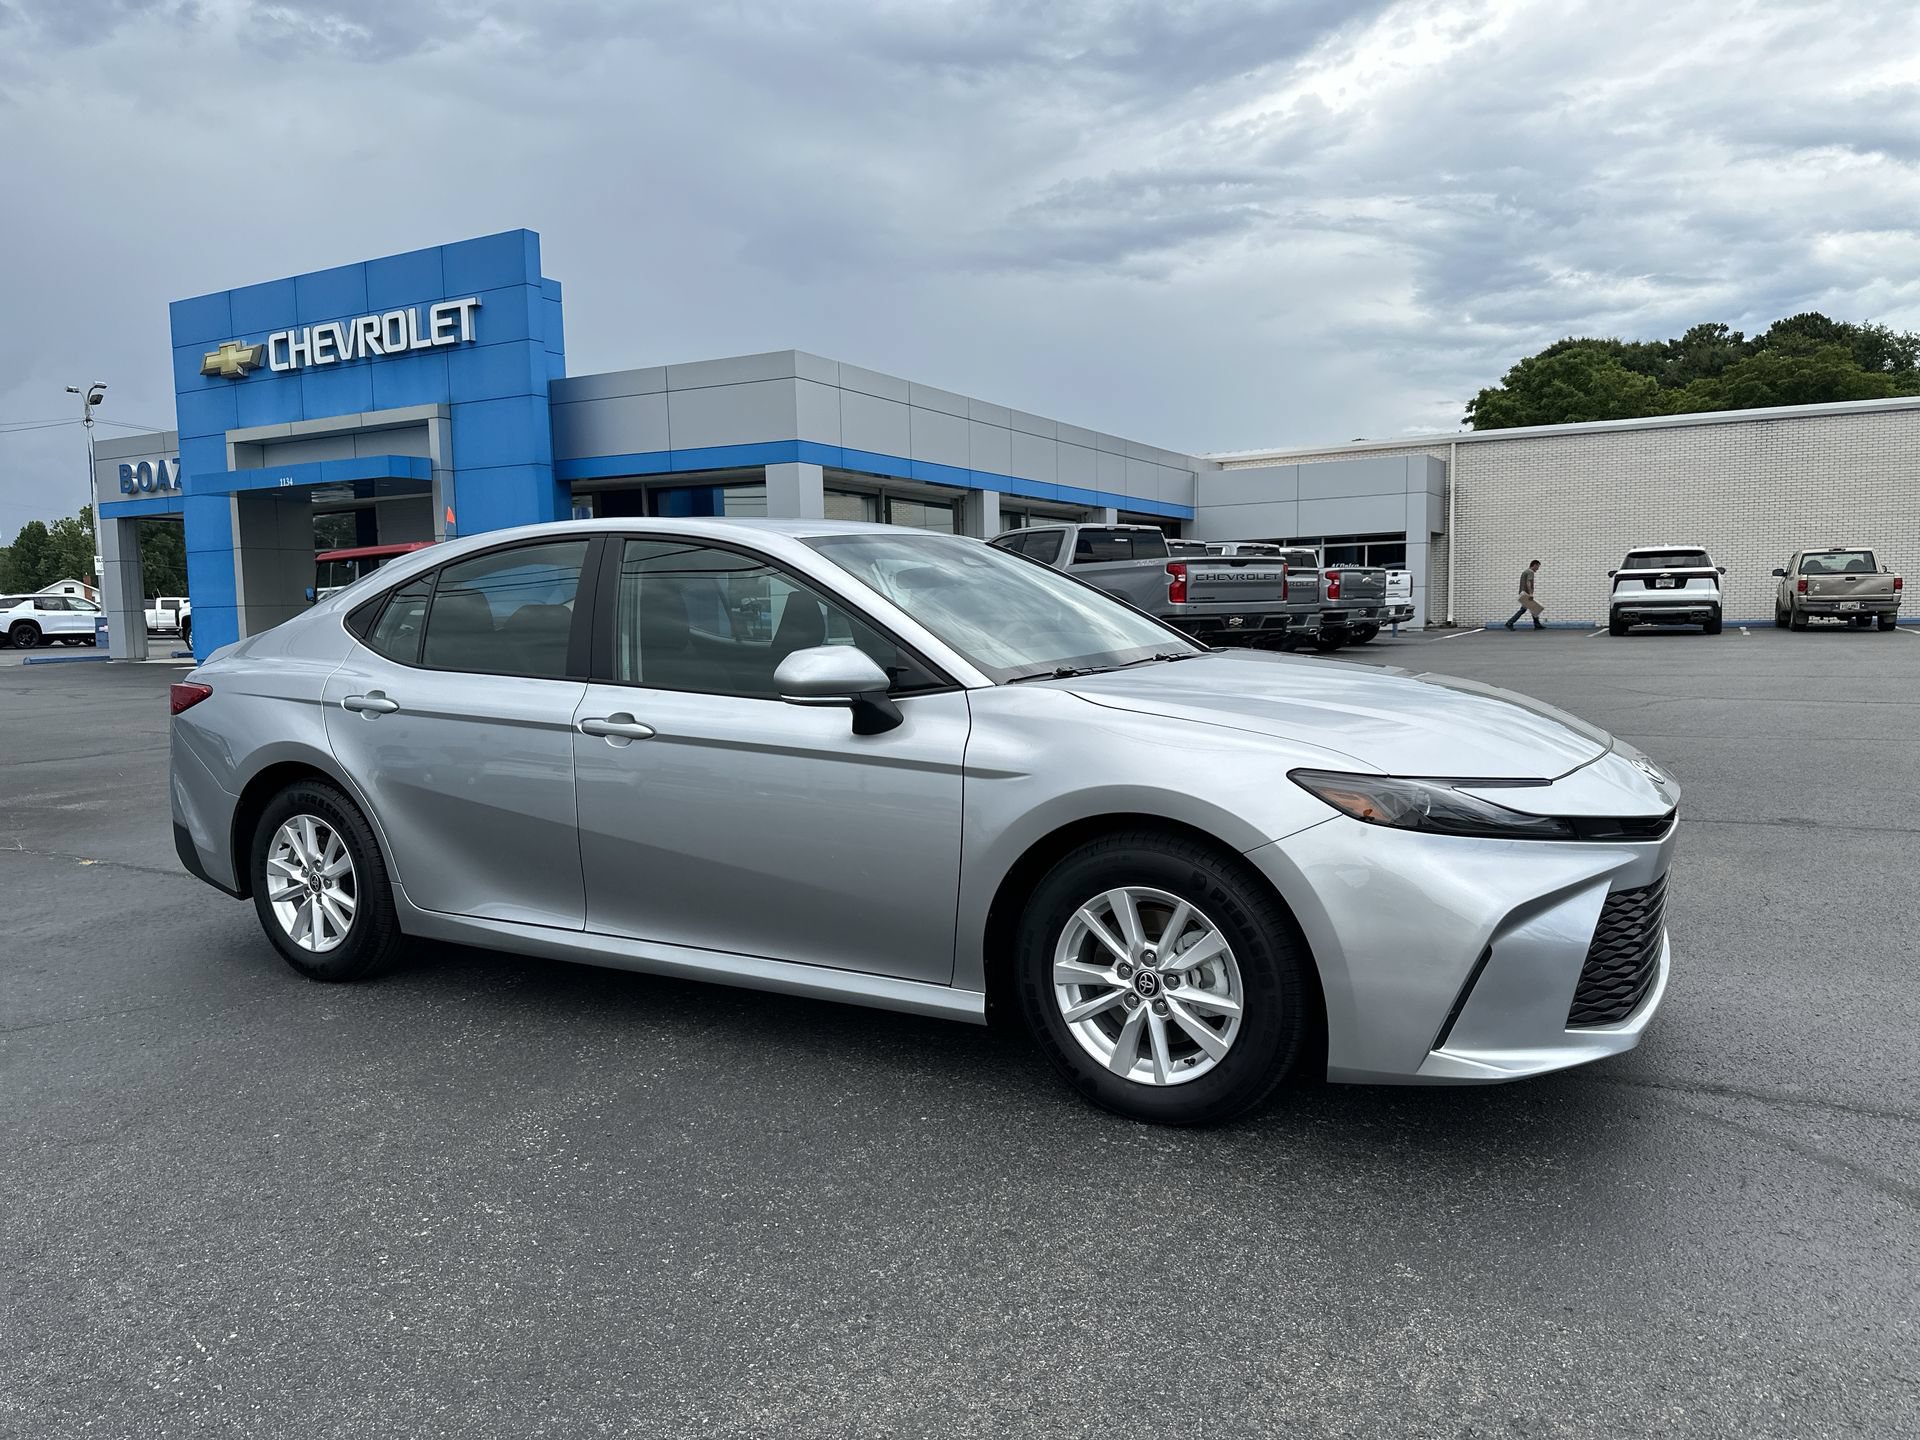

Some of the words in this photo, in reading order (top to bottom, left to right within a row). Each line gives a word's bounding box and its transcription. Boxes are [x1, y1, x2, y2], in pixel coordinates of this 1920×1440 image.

[268, 297, 481, 372] CHEVROLET
[119, 457, 182, 494] BOAZ
[279, 477, 293, 487] 1134
[1195, 573, 1280, 581] CHEVROLET
[1288, 580, 1316, 588] ROLET
